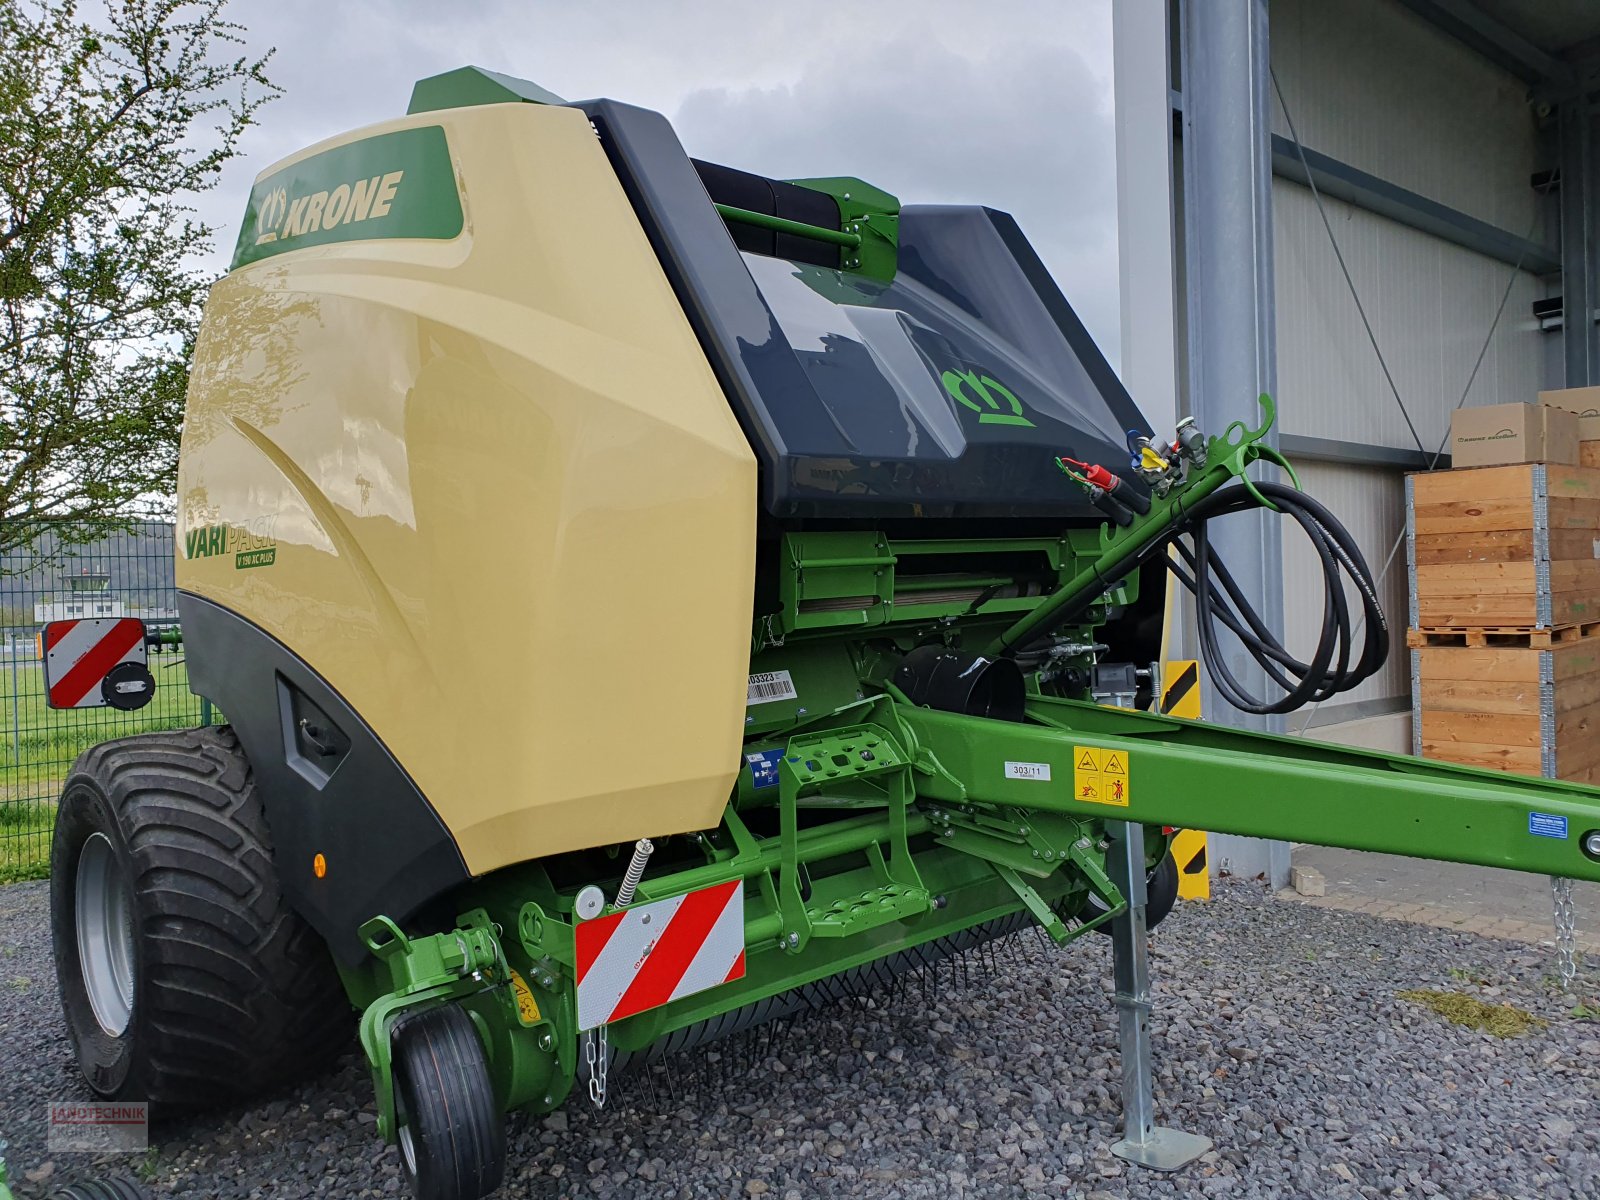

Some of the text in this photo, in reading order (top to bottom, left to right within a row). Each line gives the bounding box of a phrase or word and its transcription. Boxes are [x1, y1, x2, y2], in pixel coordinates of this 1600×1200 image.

[281, 170, 404, 240] KRONE
[186, 513, 279, 559] VARIPACK
[237, 552, 273, 567] V 190 XC PLUS
[1013, 766, 1040, 775] 303/11
